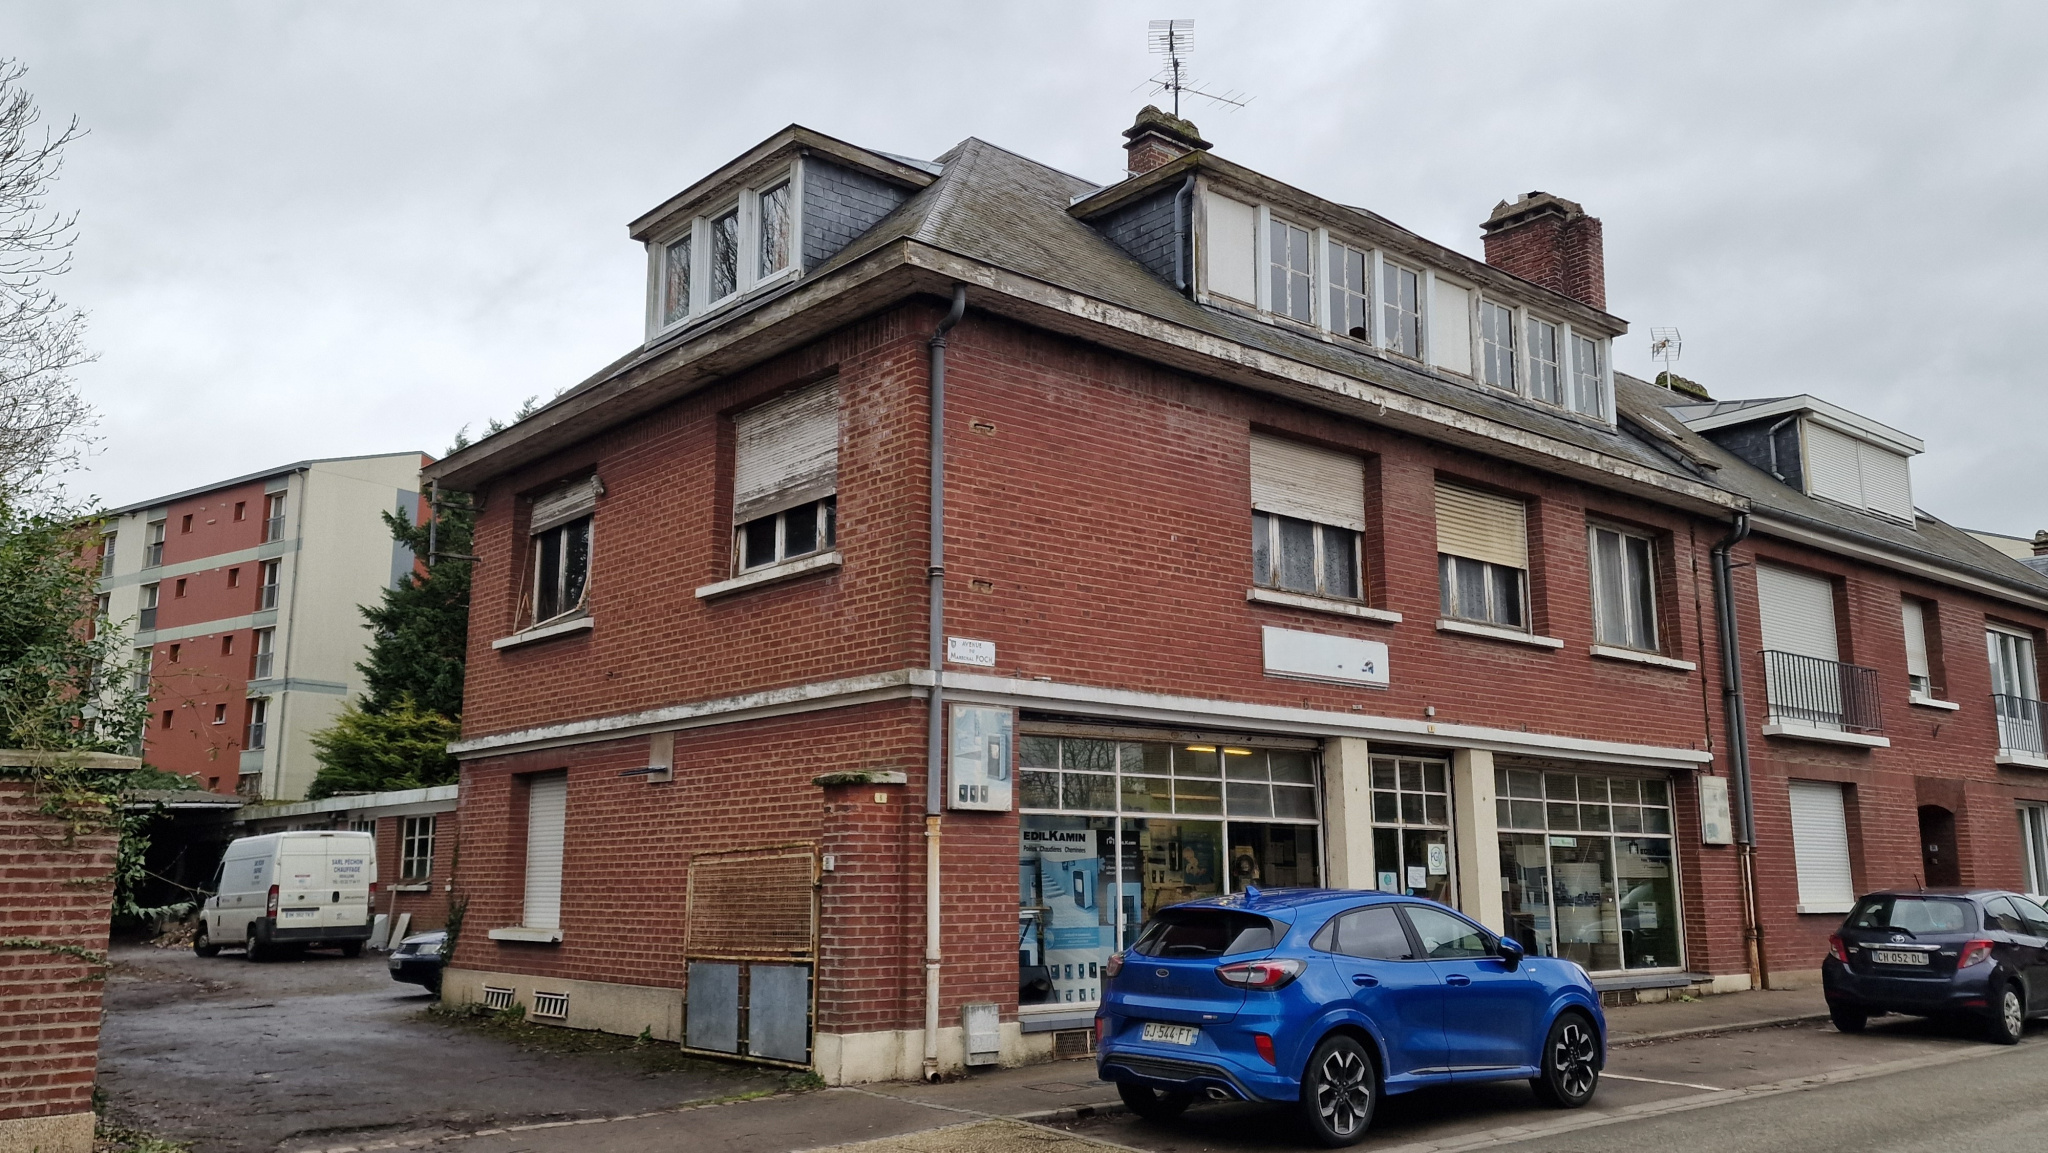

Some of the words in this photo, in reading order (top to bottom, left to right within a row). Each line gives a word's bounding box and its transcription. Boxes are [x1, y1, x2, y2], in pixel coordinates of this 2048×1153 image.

[962, 641, 982, 649] AVENUE
[975, 655, 993, 663] FOCH
[1023, 831, 1085, 842] EDILKAMIN
